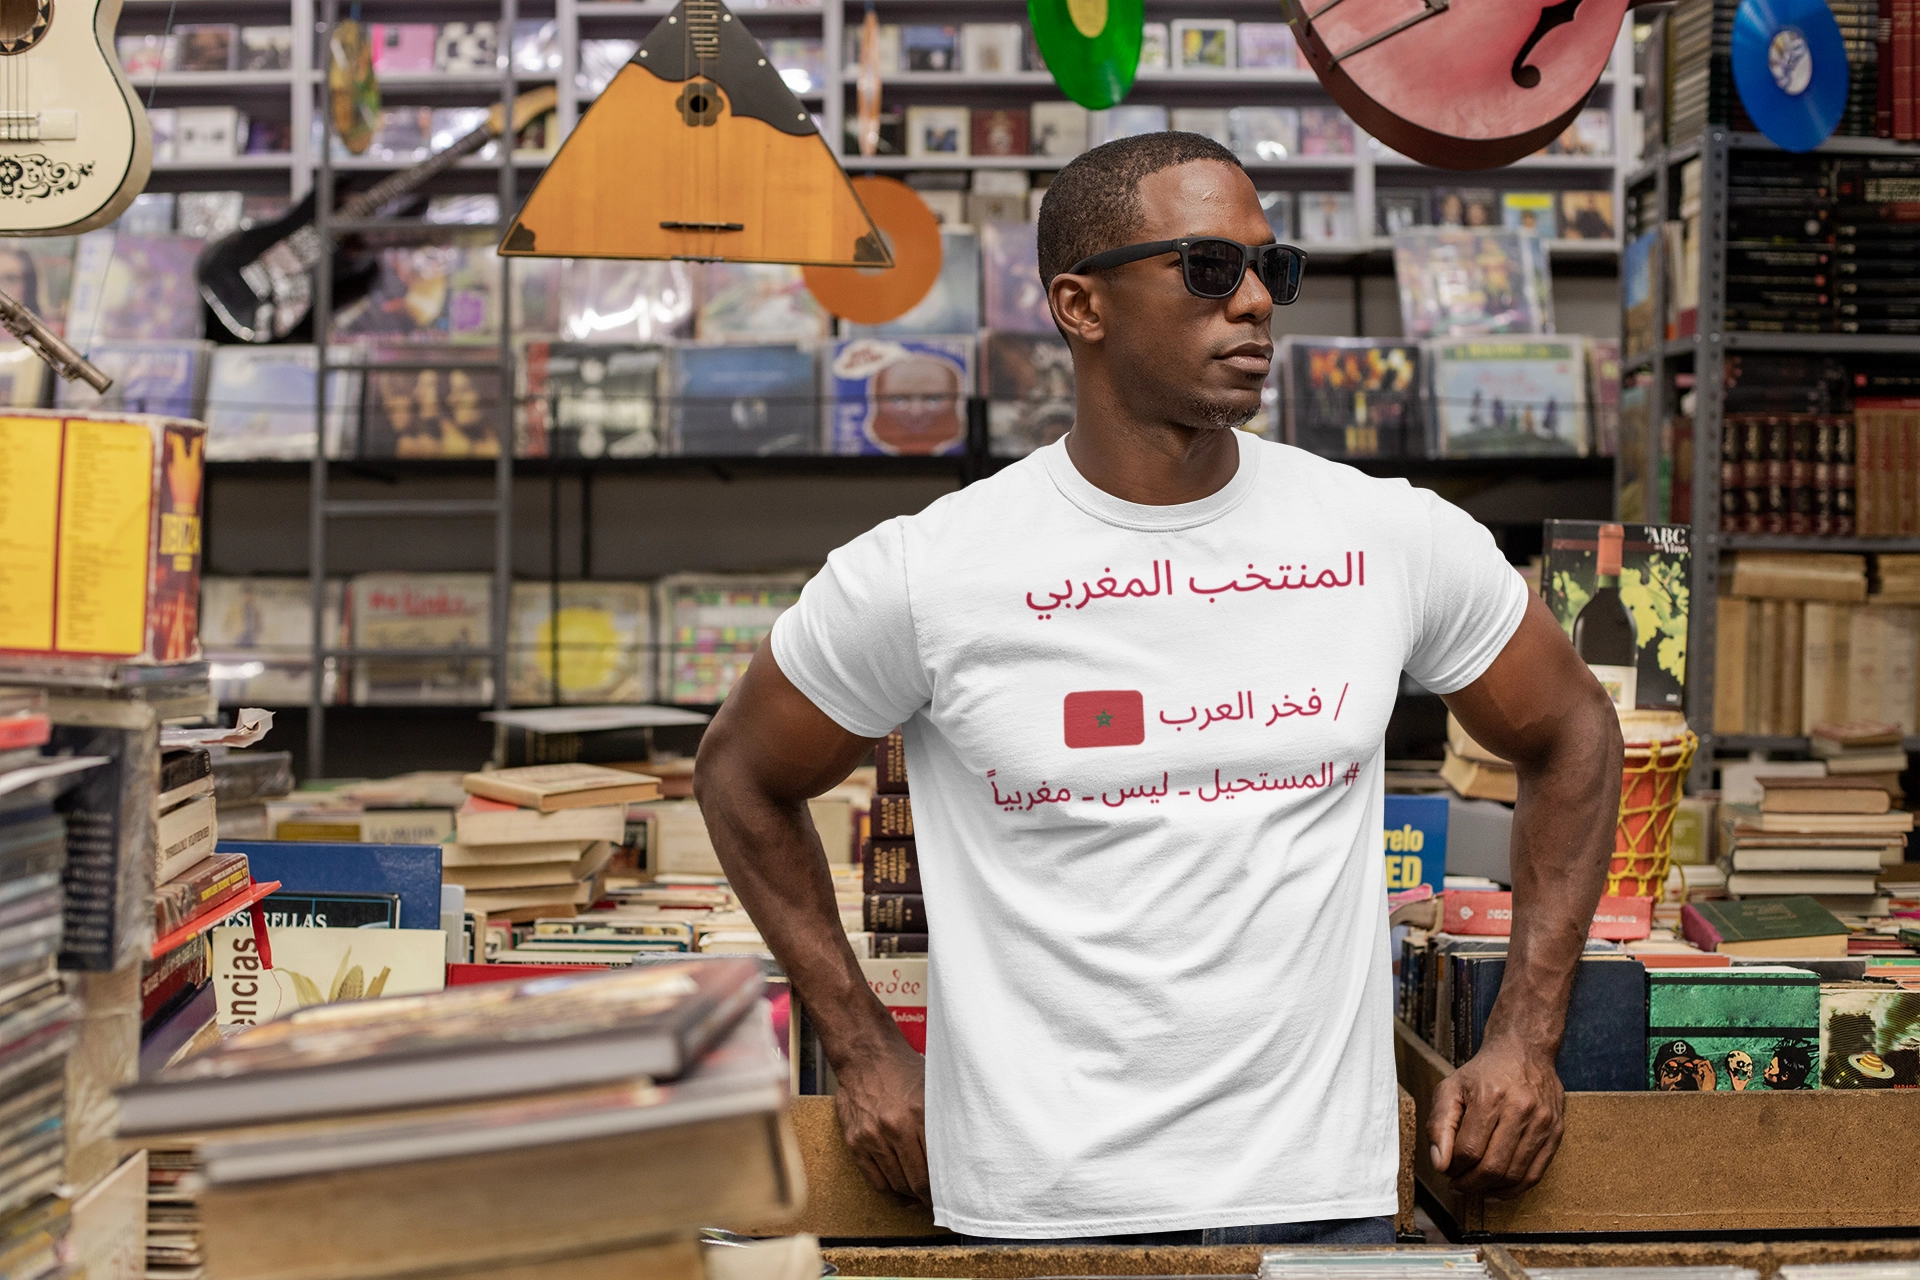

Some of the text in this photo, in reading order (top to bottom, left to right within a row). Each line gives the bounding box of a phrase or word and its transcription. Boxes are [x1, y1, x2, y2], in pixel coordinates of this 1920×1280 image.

[1648, 527, 1686, 545] ABC
[1025, 550, 1365, 621] المنتخب المغربي
[1159, 690, 1255, 732] العرب
[1265, 687, 1323, 727] فخر
[1101, 771, 1169, 808] ليس
[1197, 761, 1334, 803] المستحيل
[225, 911, 328, 928] ESRELLAS
